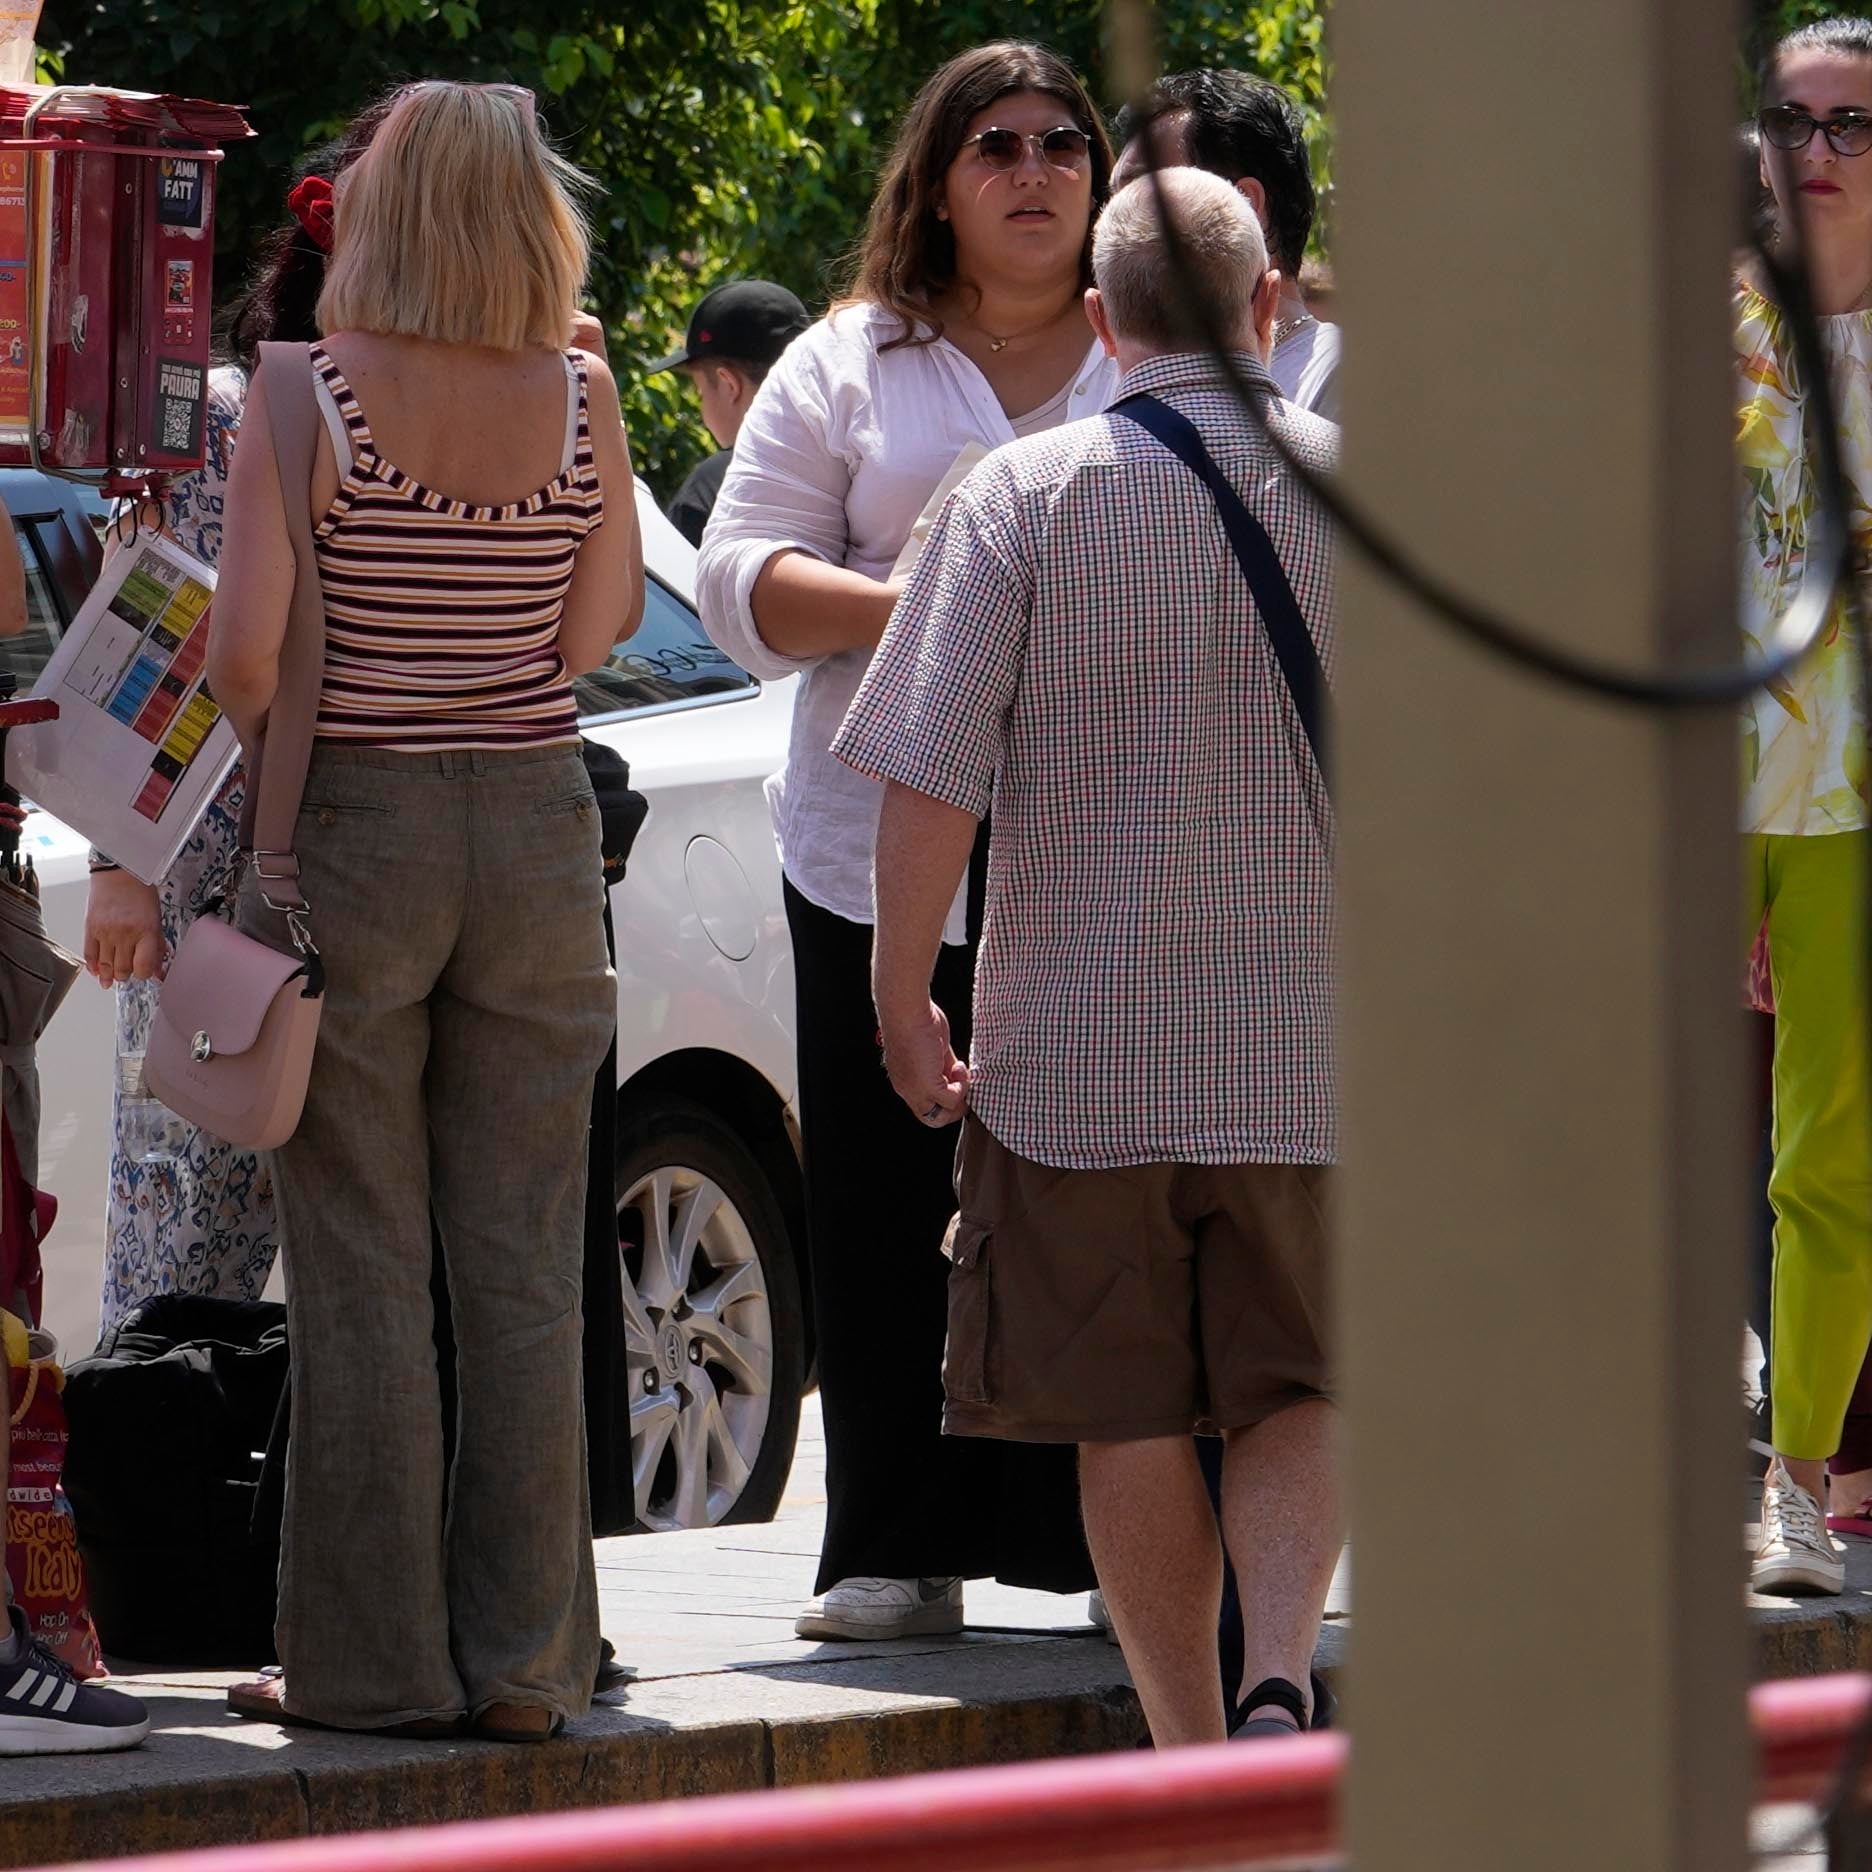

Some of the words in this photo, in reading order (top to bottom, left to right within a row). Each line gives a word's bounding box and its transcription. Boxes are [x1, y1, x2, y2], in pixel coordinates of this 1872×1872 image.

[165, 180, 193, 200] FATT
[160, 373, 200, 400] PAURA
[9, 1489, 51, 1501] dwide
